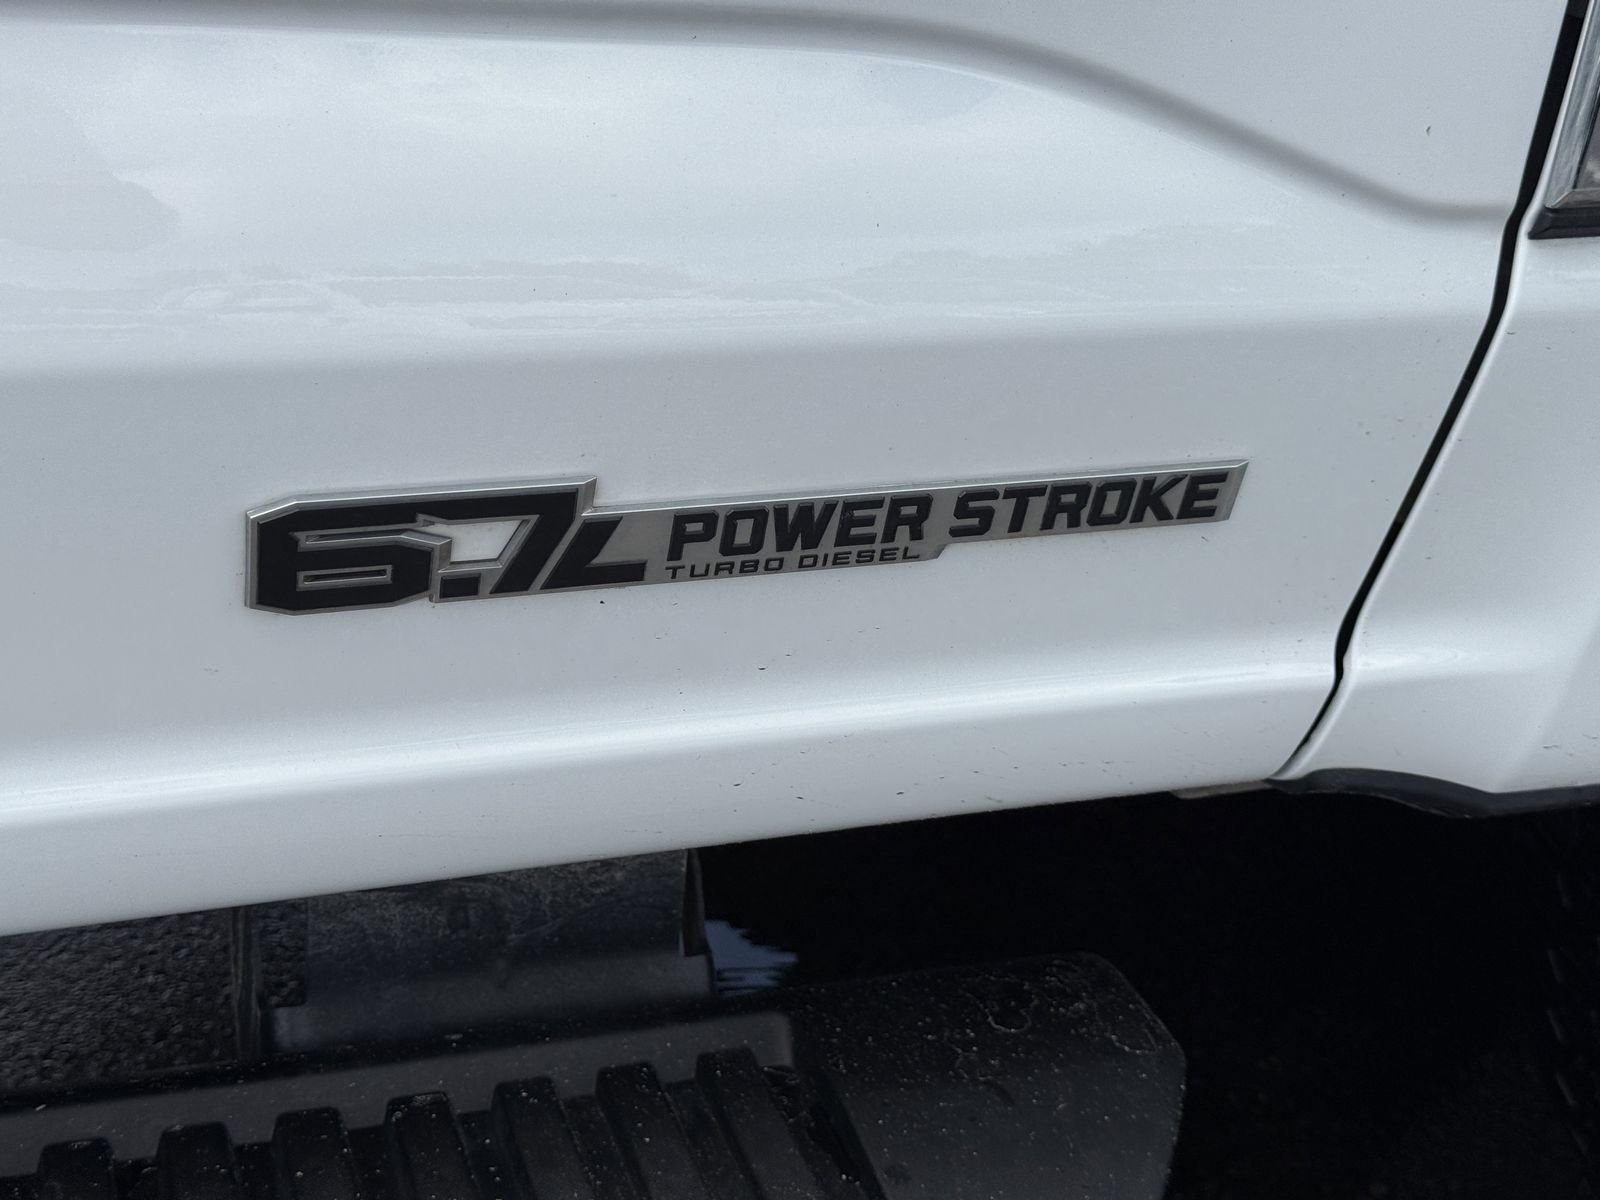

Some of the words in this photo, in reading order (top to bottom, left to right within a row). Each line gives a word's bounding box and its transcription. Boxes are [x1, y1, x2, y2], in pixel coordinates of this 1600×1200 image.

[256, 488, 648, 607] 6.7L
[666, 492, 934, 561] POWER
[948, 471, 1230, 538] STROKE
[665, 557, 786, 580] TURBO
[797, 546, 921, 569] DIESEL
